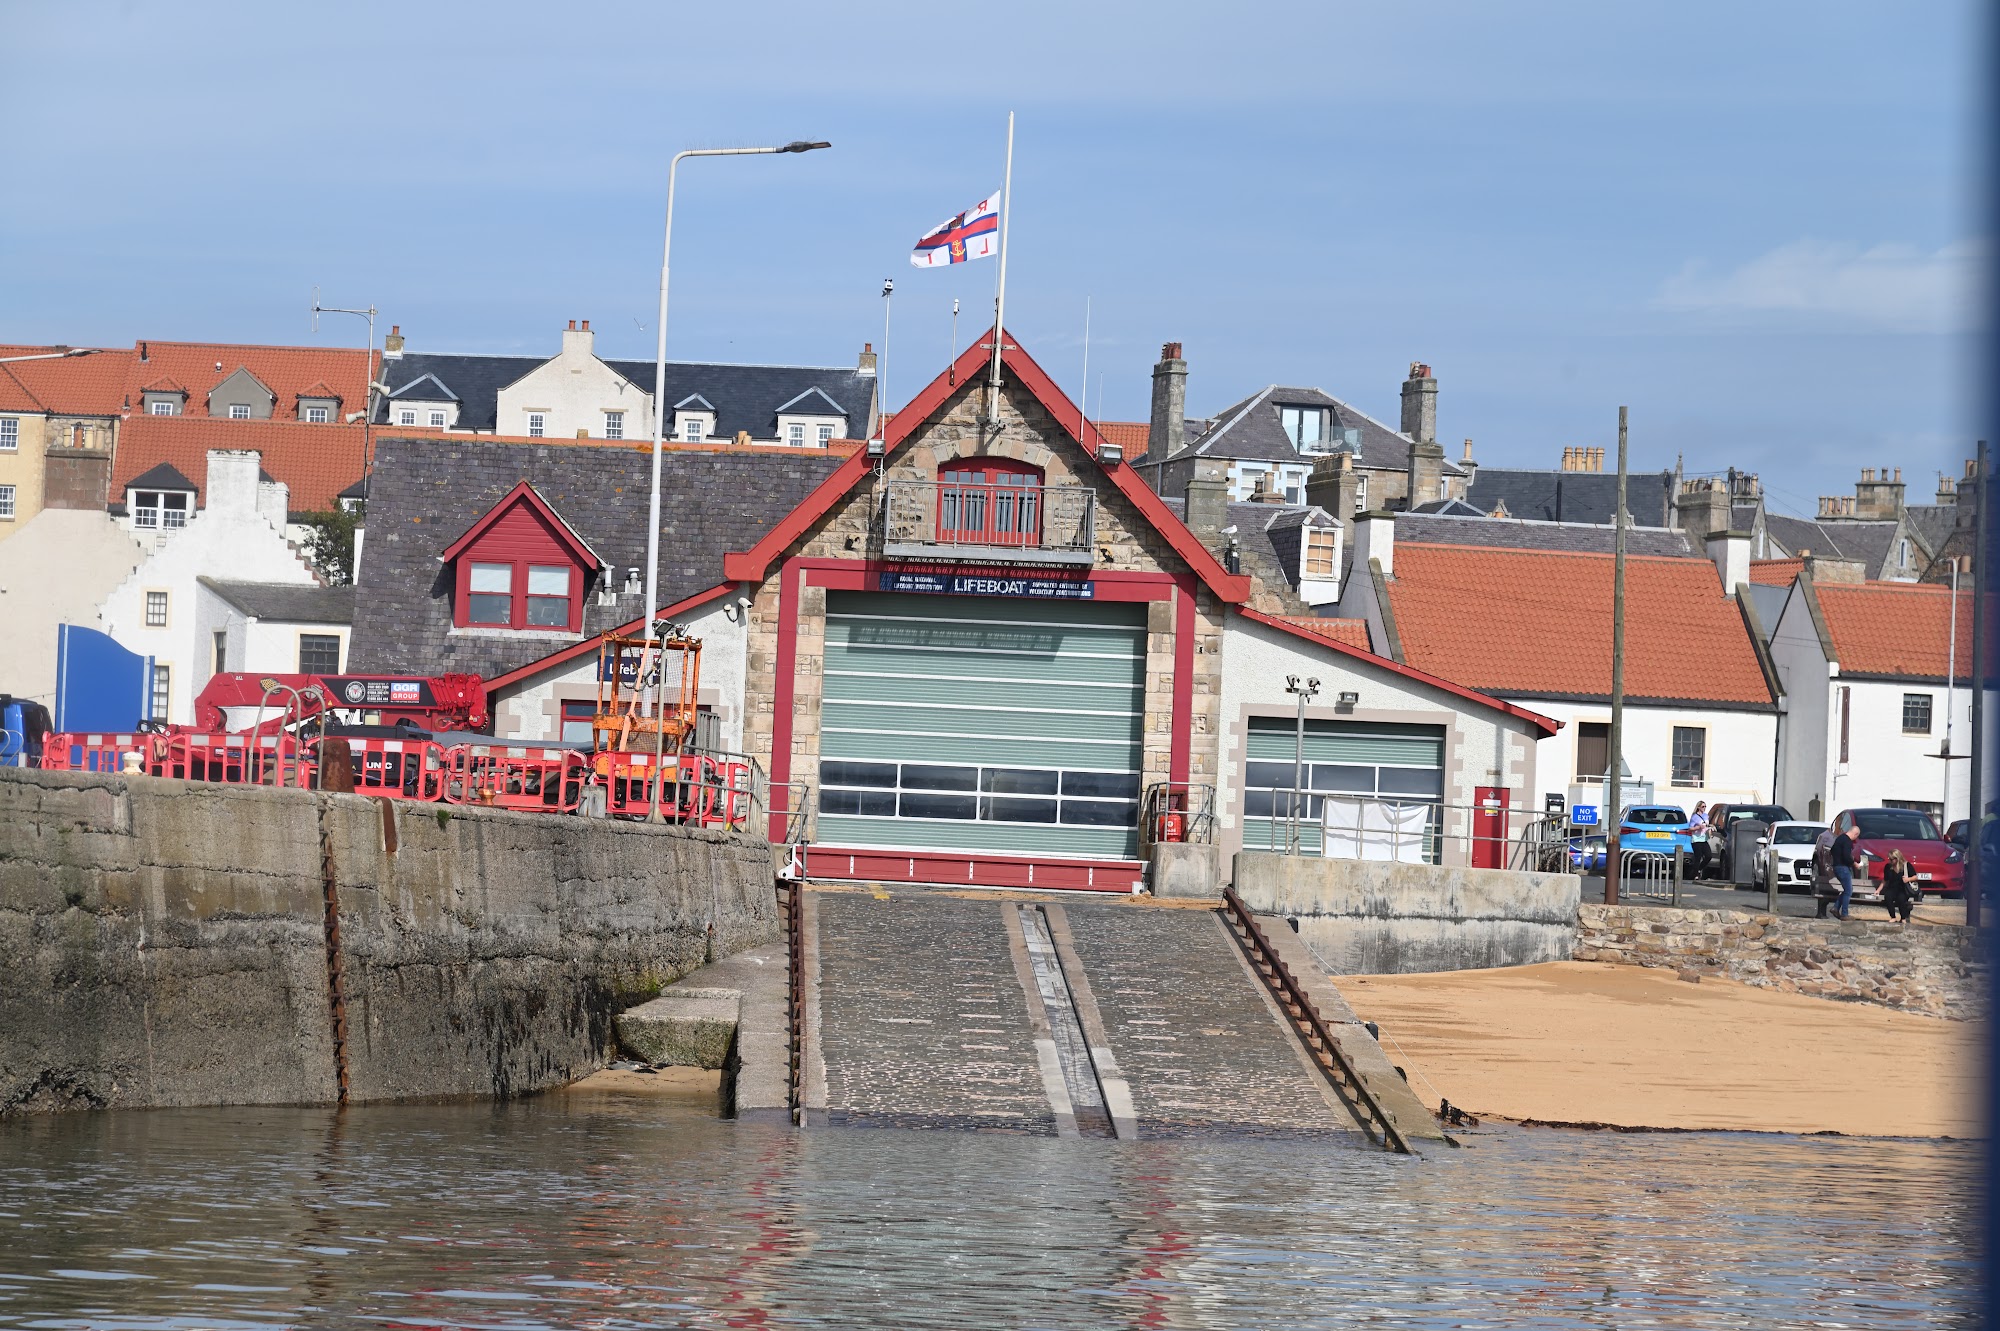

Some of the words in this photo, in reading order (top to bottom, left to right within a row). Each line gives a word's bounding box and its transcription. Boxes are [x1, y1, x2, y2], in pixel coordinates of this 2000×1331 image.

[954, 578, 1028, 594] LIFEBOAT
[393, 684, 418, 692] GGR
[366, 761, 393, 770] UNC
